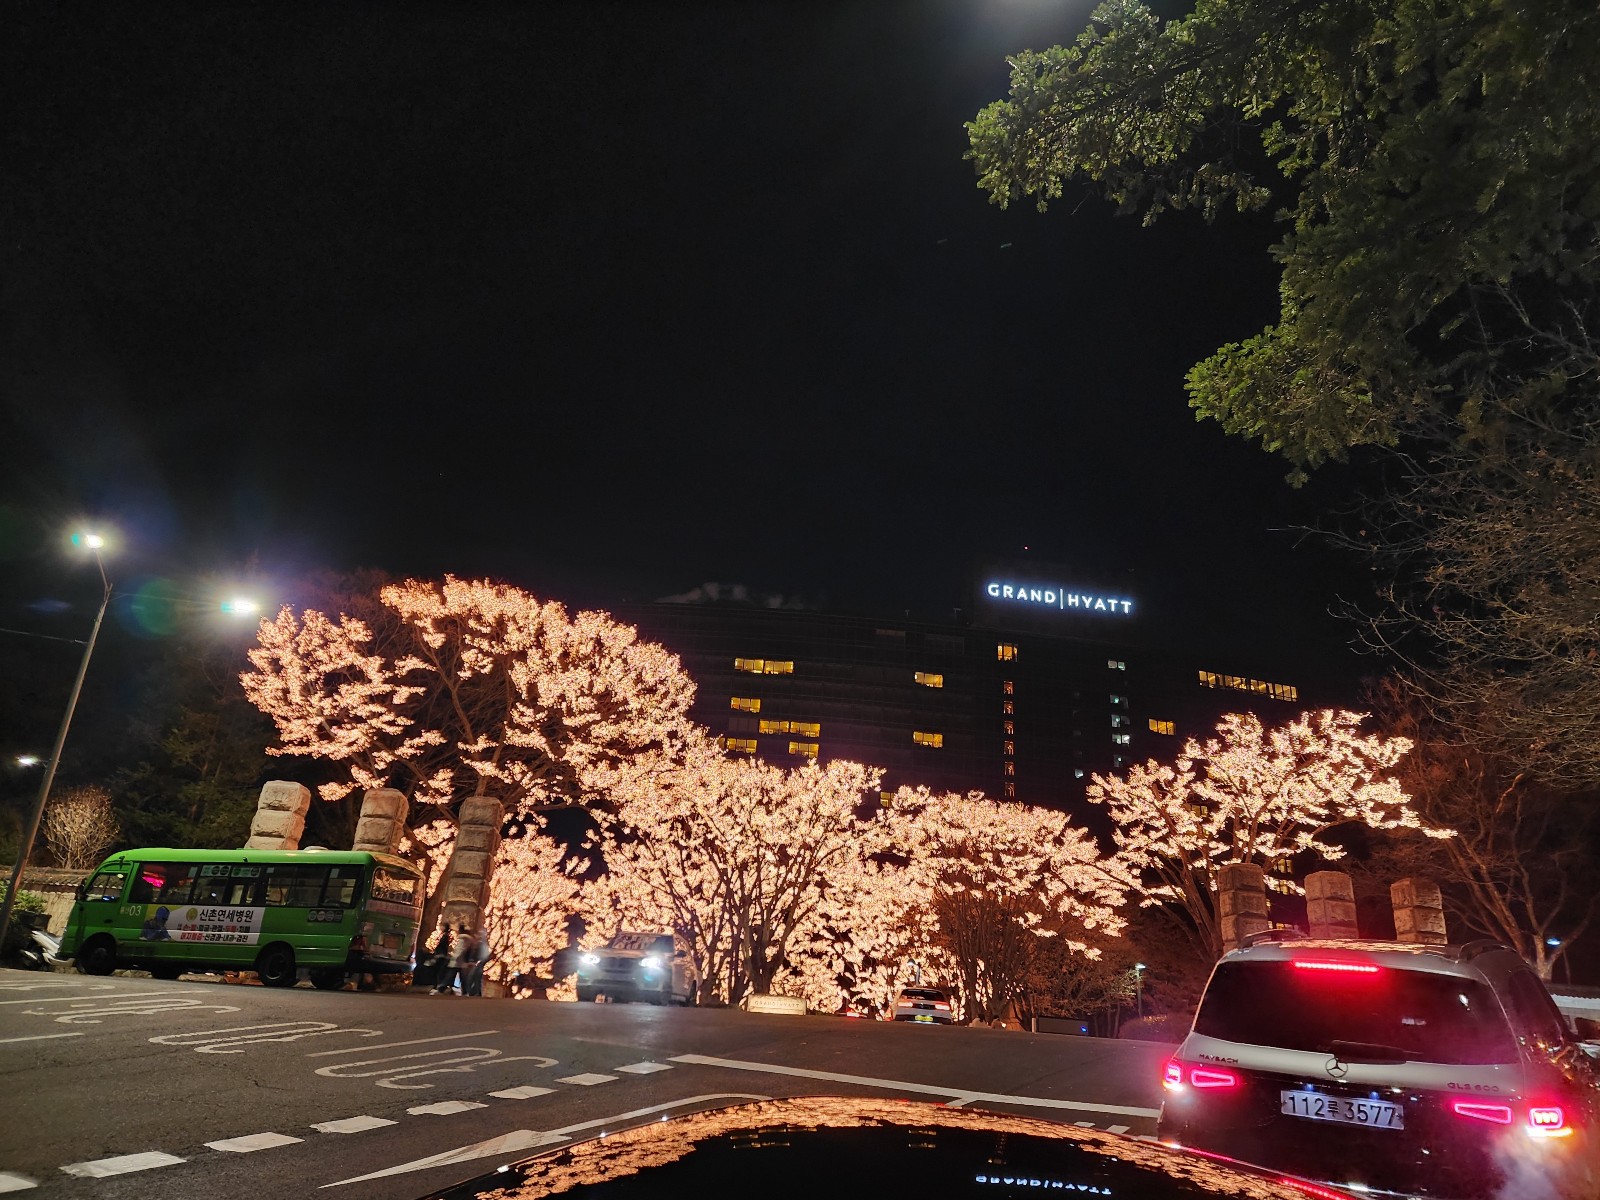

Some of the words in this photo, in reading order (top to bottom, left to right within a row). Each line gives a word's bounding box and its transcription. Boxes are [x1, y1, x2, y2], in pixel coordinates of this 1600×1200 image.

[987, 582, 1057, 604] GRAND
[1067, 593, 1132, 614] HYATT
[200, 909, 254, 923] 신촌연세병원
[1199, 1054, 1239, 1064] MAYBACH
[1288, 1094, 1339, 1118] 112루
[1344, 1101, 1396, 1127] 3577
